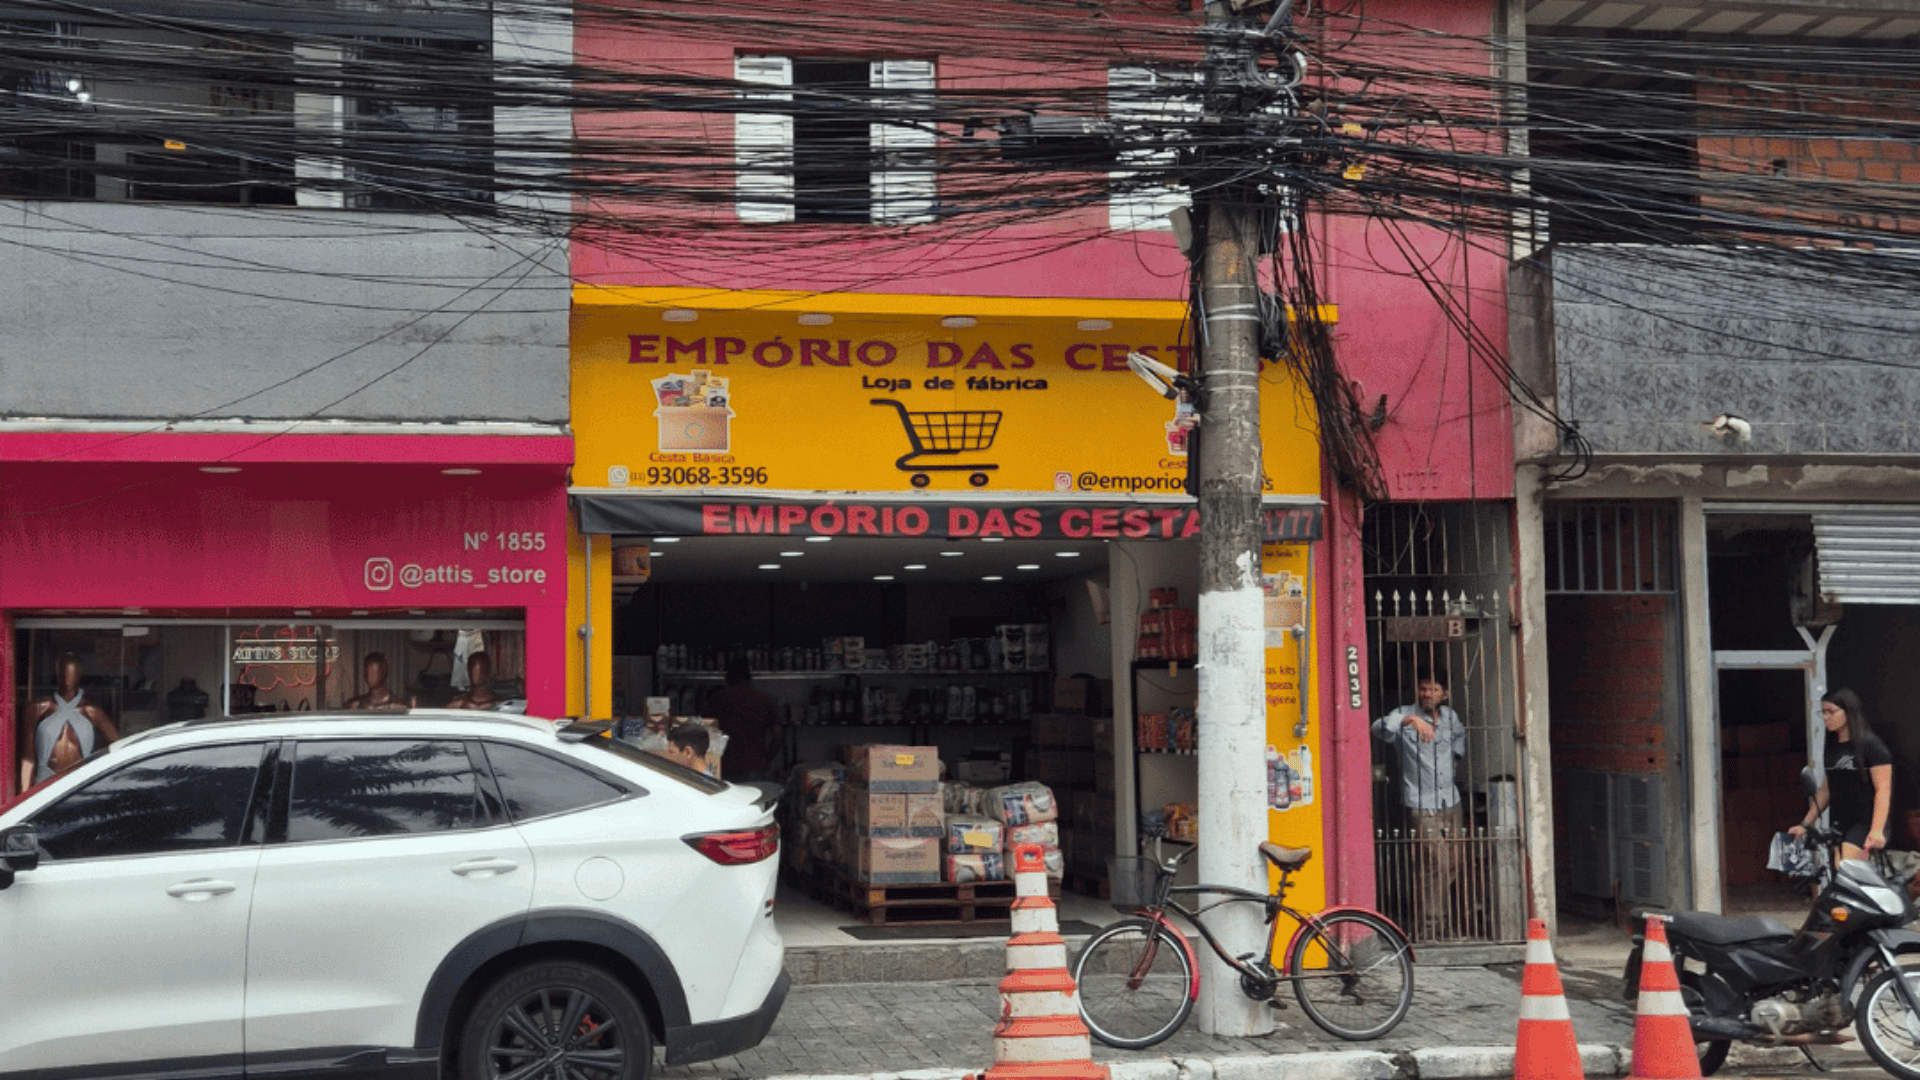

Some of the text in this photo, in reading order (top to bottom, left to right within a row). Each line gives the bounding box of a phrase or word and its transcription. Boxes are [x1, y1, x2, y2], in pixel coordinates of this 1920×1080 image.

[627, 334, 897, 368] EMPÓRIO
[926, 341, 1035, 370] DAS
[862, 375, 1048, 392] Loja de fábrica
[648, 452, 736, 463] Cesta Básica
[647, 466, 769, 485] 93068-3596
[702, 500, 931, 536] EMPÓRIO
[948, 507, 1043, 538] DAS
[1059, 507, 1201, 539] CESTA
[464, 532, 547, 551] Nº 1855
[400, 563, 547, 588] @attis_store
[1448, 619, 1462, 637] B
[1346, 646, 1362, 708] 2035
